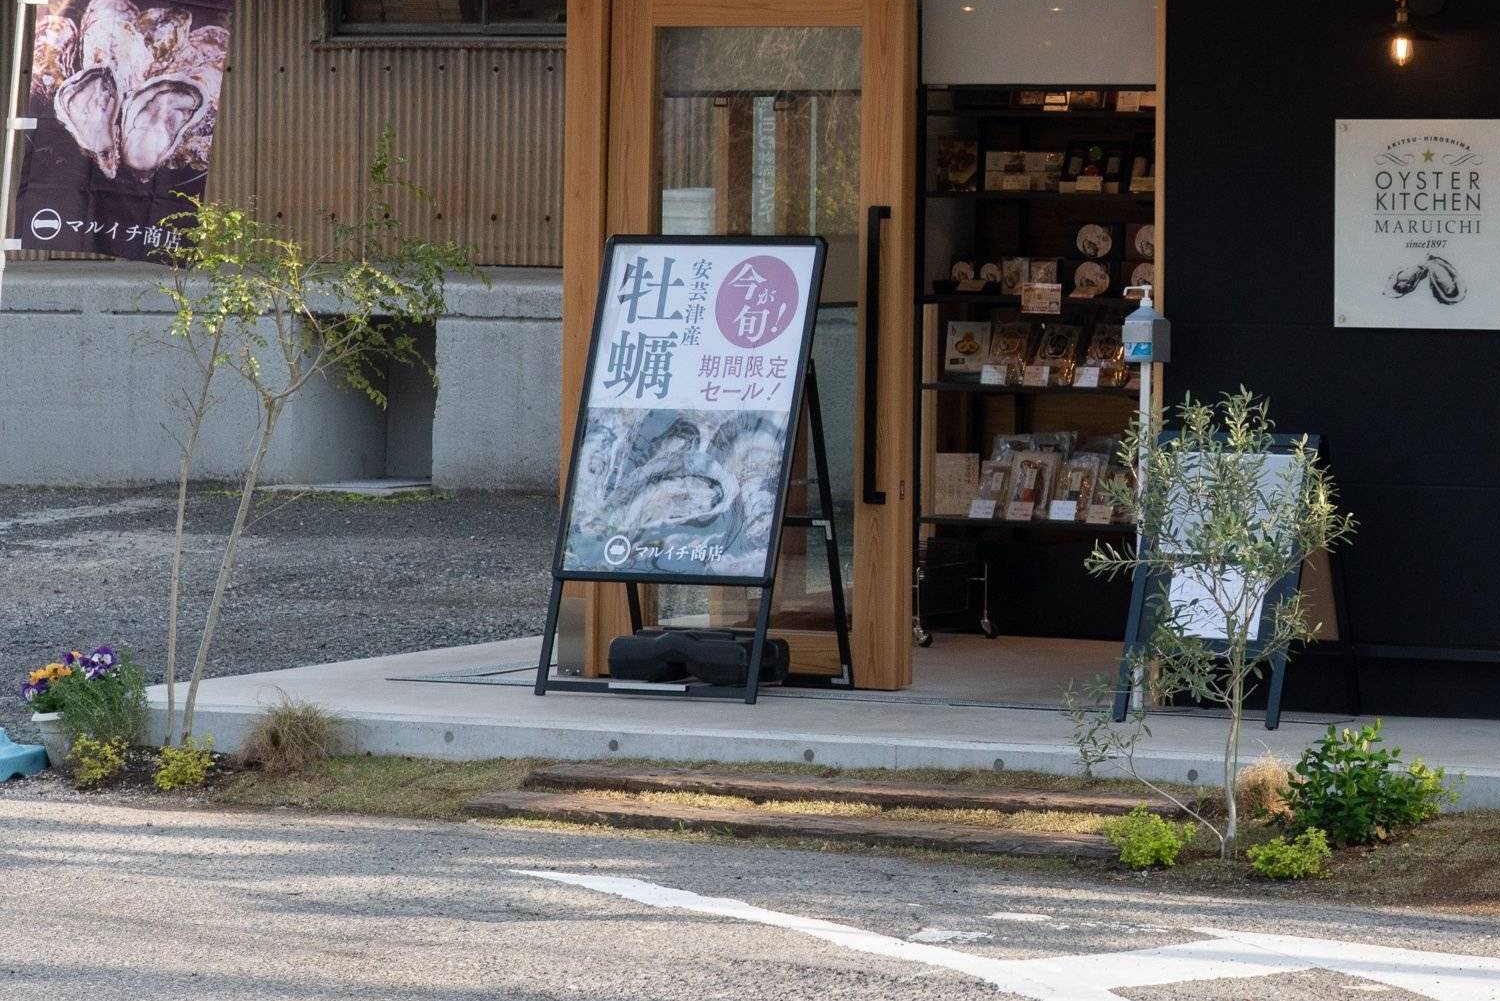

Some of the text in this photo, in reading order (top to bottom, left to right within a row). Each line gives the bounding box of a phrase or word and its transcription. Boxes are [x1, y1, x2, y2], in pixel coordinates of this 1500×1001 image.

[1375, 171, 1480, 190] OYSTER
[1376, 192, 1481, 211] KITCHEN
[66, 220, 181, 251] マルイチ商店
[1375, 219, 1480, 234] MARUICHI
[680, 259, 712, 346] 安芸津産
[604, 256, 684, 399] 牡蠣
[698, 355, 788, 378] 期間限定
[635, 545, 725, 562] マルイチ商店
